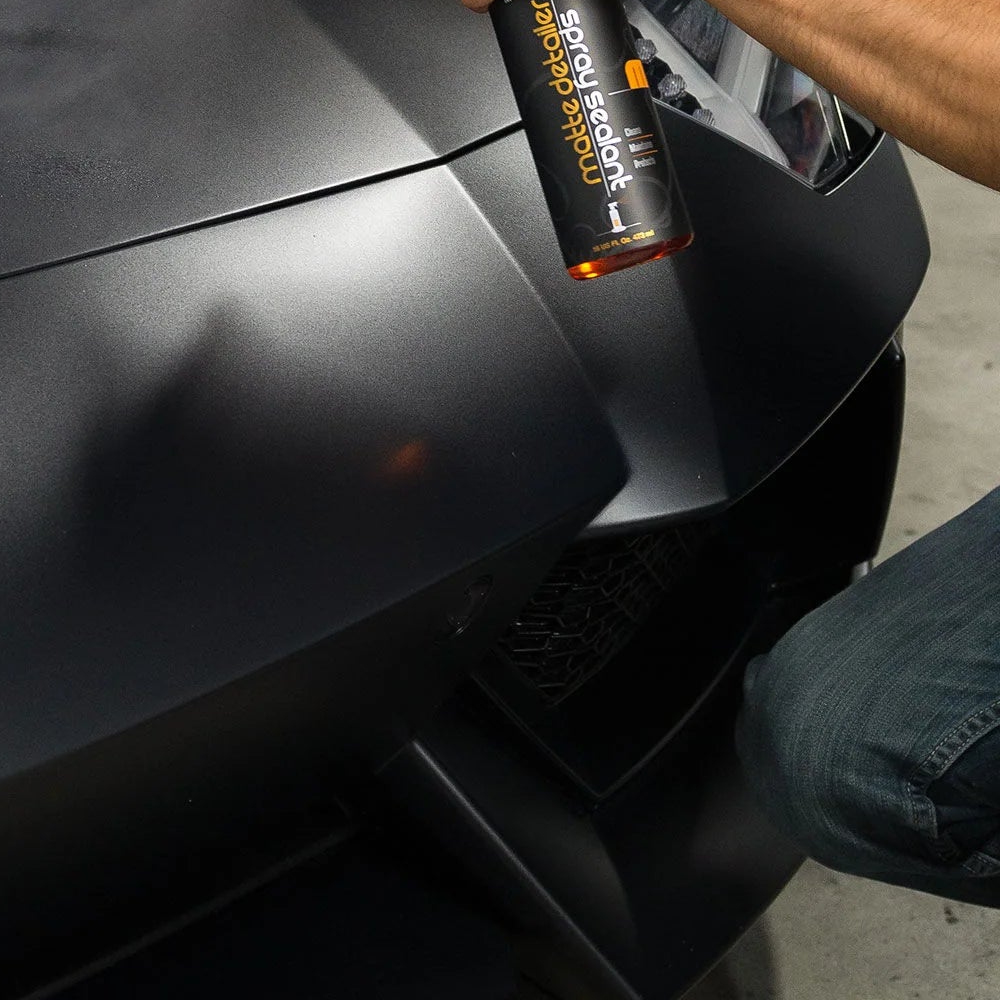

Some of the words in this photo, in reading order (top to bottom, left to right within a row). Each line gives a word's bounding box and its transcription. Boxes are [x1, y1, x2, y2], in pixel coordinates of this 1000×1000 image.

[530, 0, 575, 96] detailer
[558, 8, 599, 89] spray
[584, 90, 633, 192] sealant
[561, 98, 602, 185] matte
